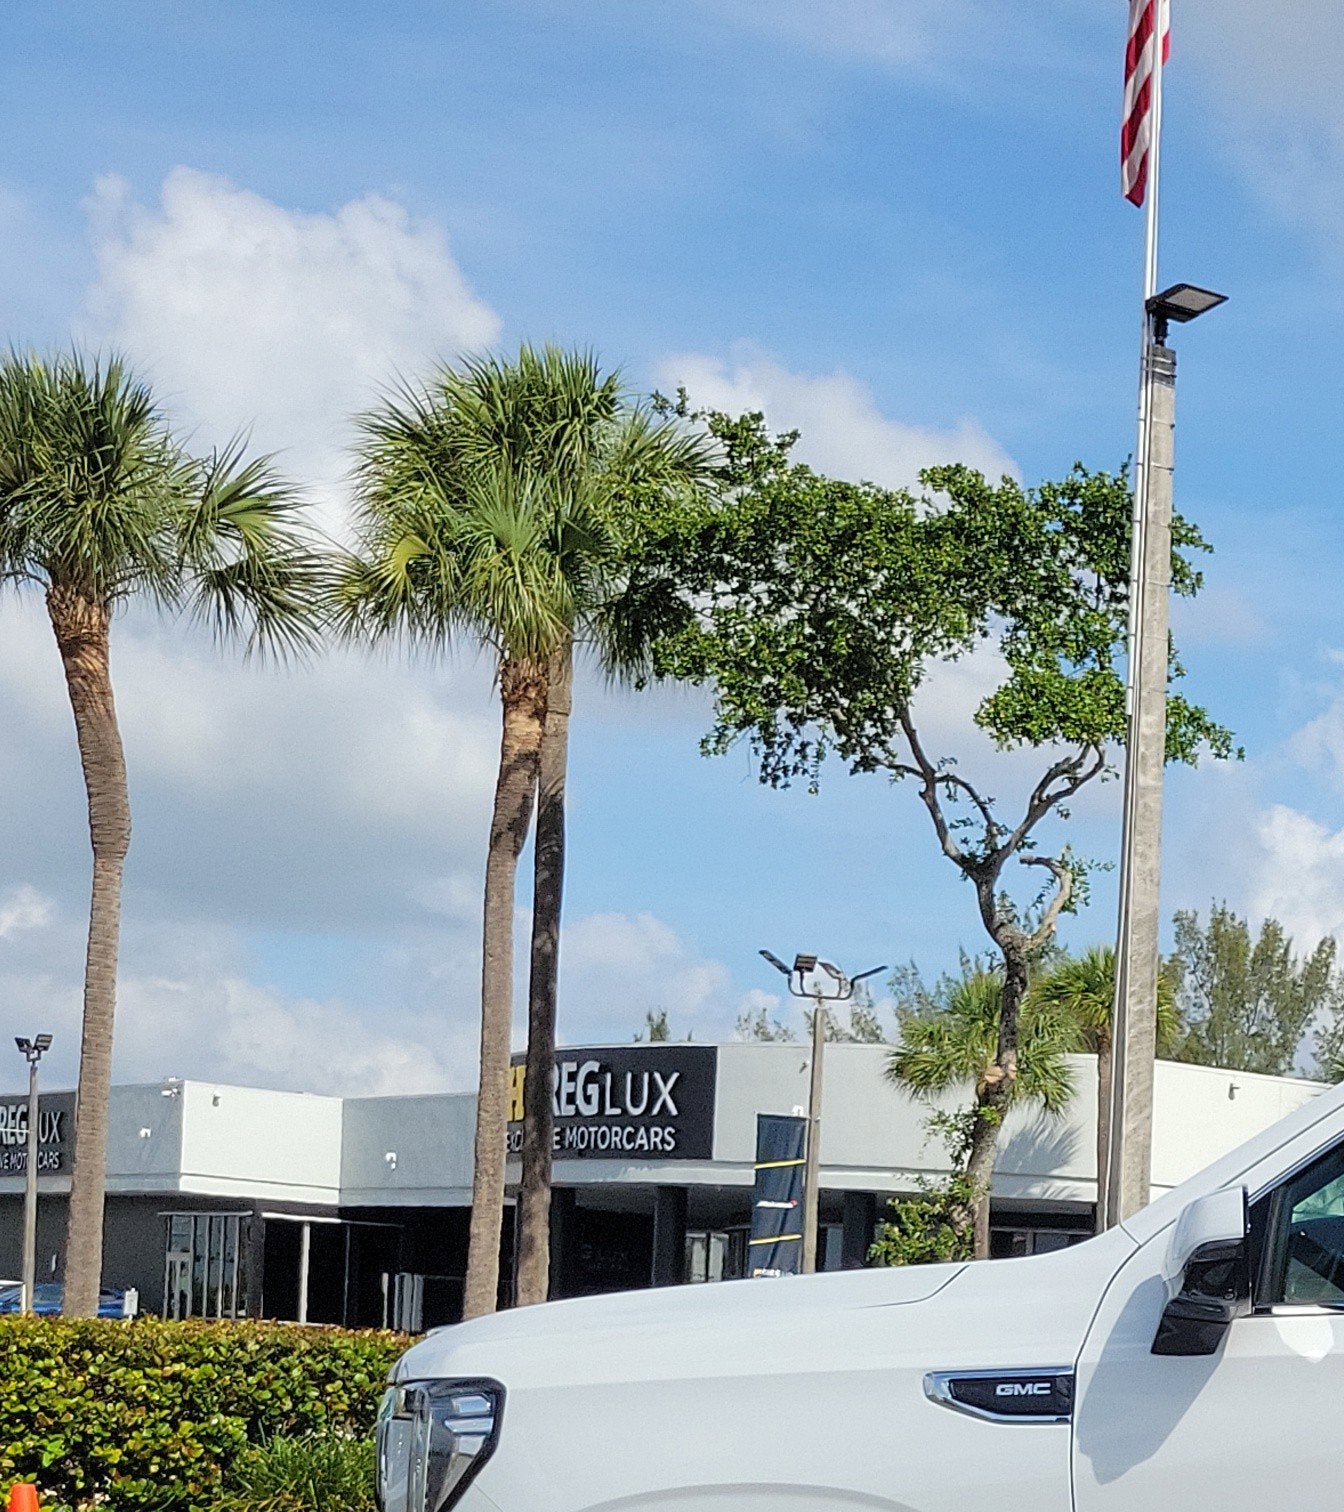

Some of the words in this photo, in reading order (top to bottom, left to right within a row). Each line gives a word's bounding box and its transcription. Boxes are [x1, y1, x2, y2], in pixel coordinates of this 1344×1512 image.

[565, 1126, 676, 1151] MOTORCARS
[10, 1151, 60, 1170] MOTCARS
[995, 1382, 1051, 1396] GMC
